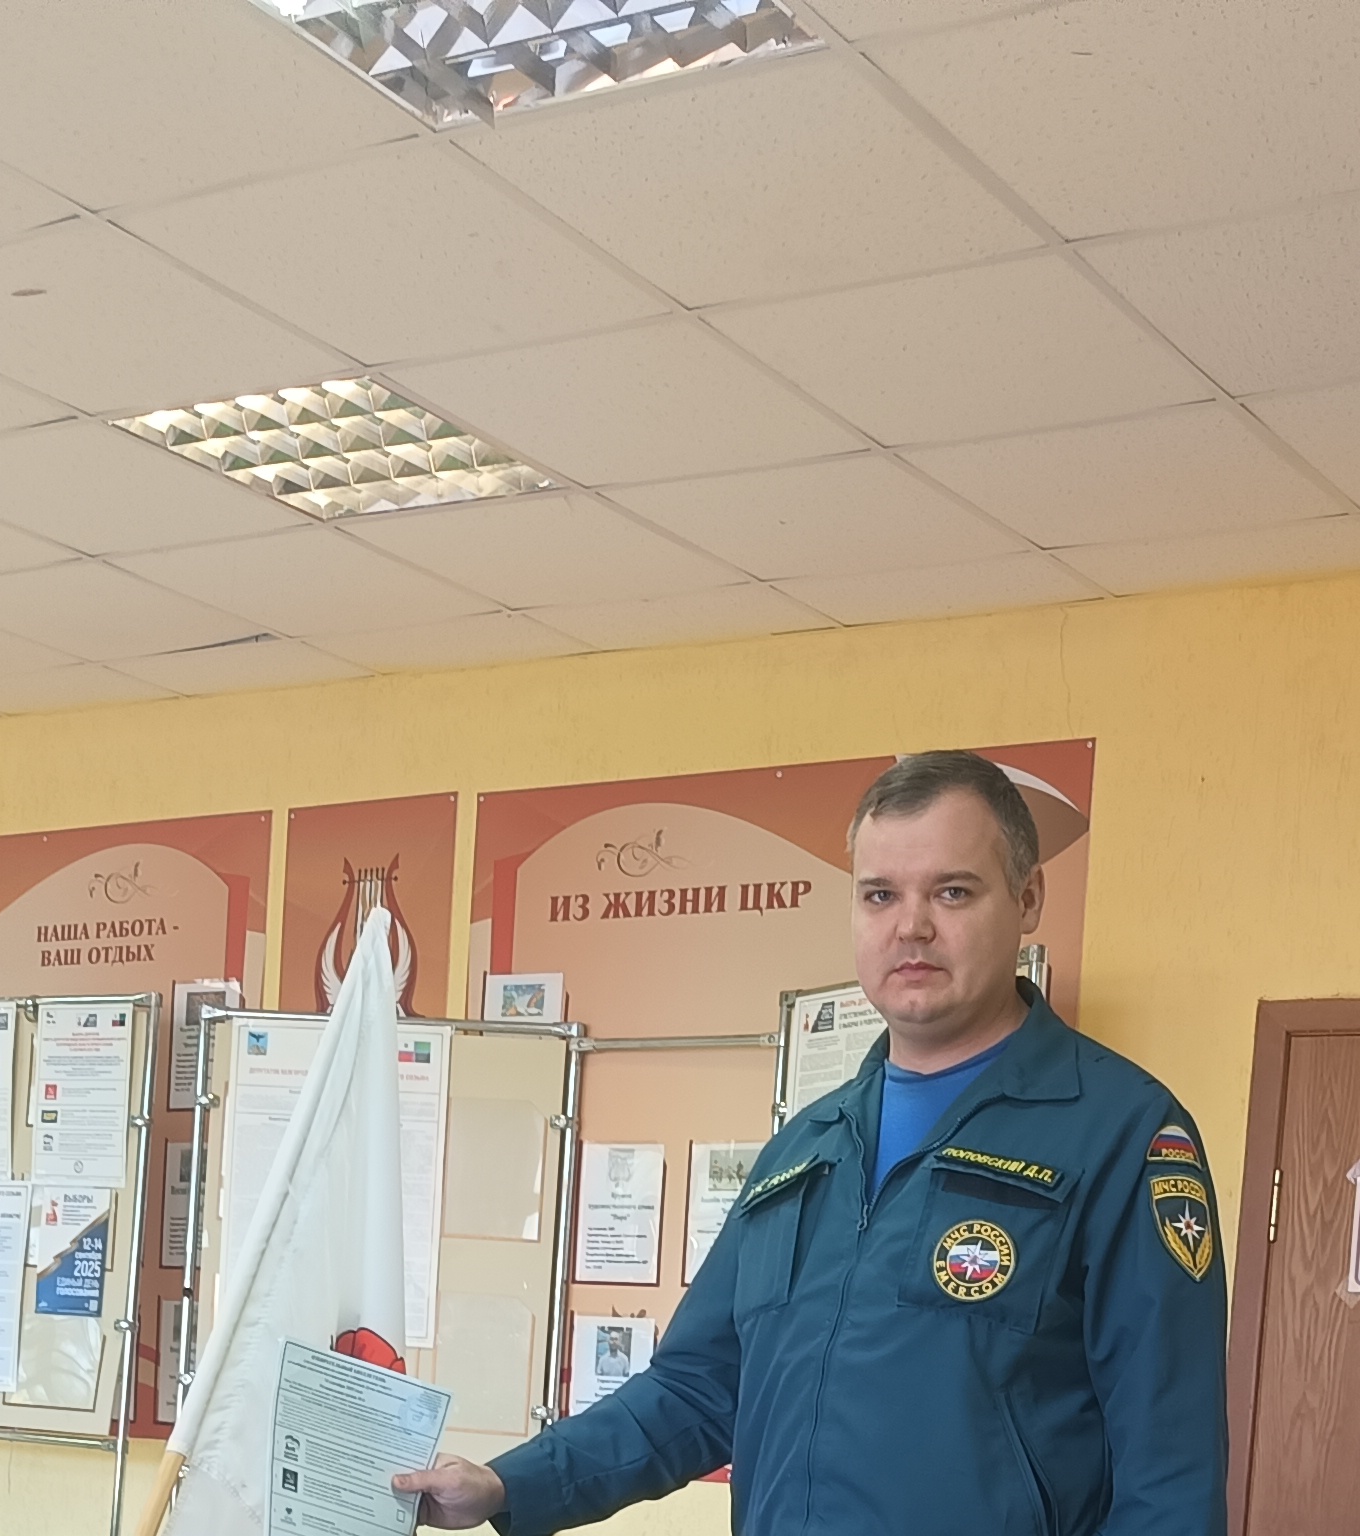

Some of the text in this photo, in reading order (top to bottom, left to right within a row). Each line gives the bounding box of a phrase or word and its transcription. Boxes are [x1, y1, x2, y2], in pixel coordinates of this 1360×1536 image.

[548, 880, 812, 922] ИЗ ЖИЗНИ ЦКР
[36, 922, 90, 943] НАША
[95, 917, 167, 939] РАБОТА
[40, 944, 155, 967] ВАШ ОТДЫХ
[1154, 1180, 1177, 1195] МЧС
[942, 1223, 1012, 1266] МЧС РОССИИ
[73, 1260, 102, 1277] 2025
[936, 1260, 1007, 1298] EMERCOM
